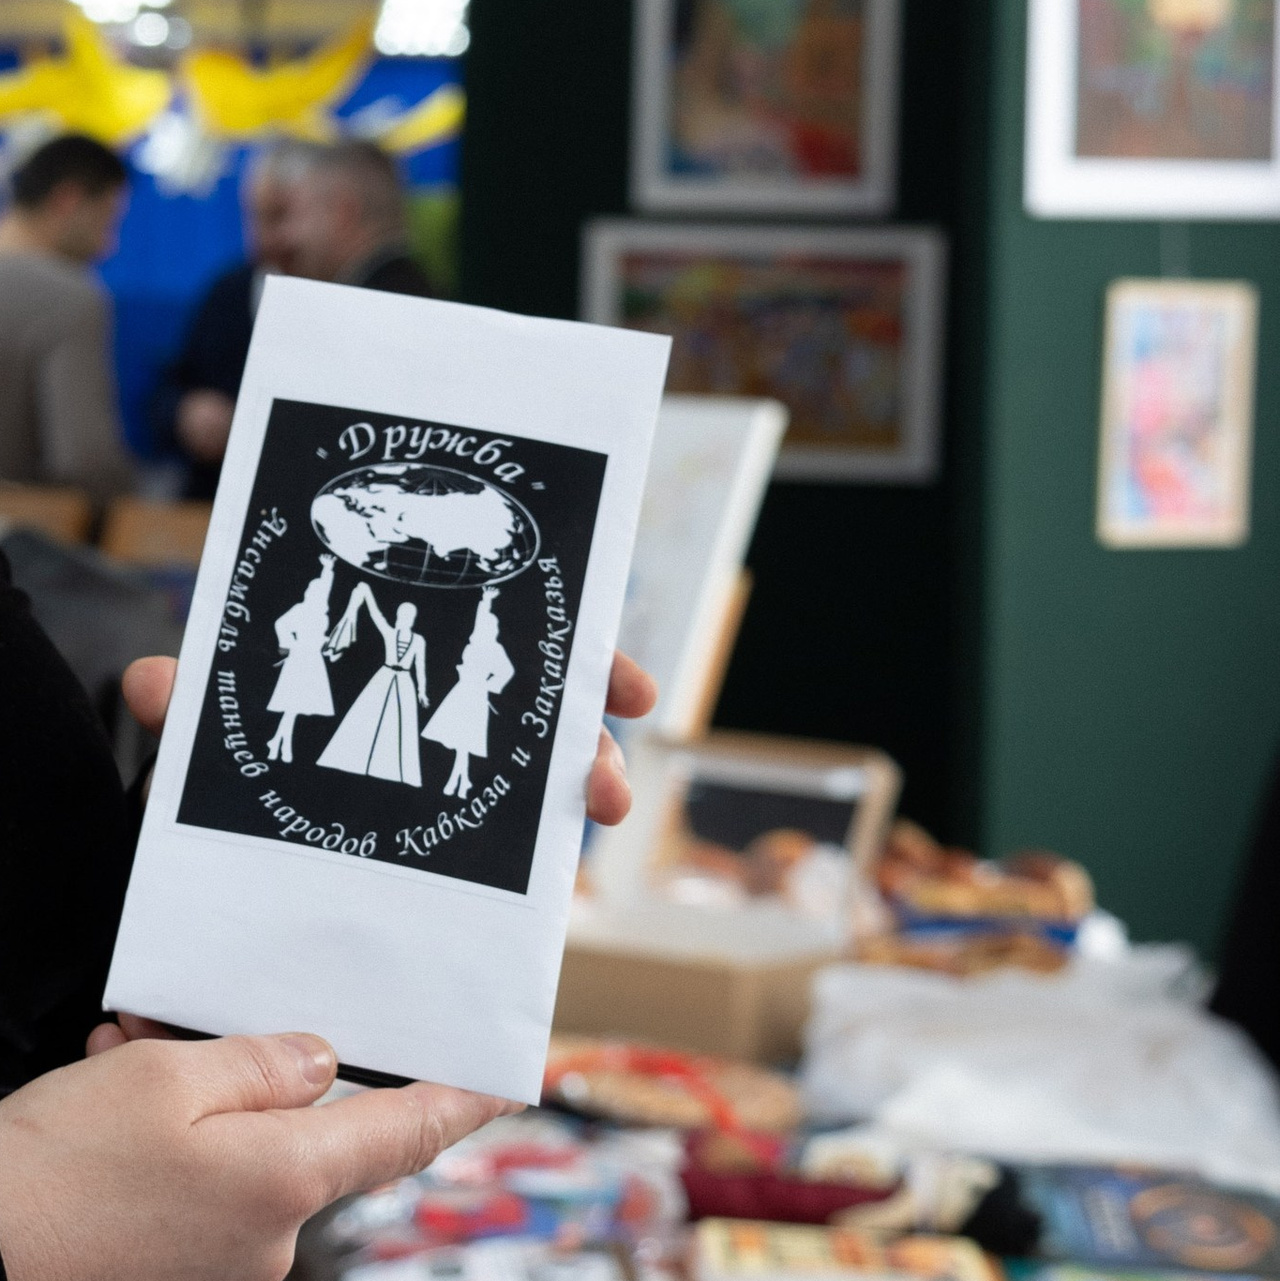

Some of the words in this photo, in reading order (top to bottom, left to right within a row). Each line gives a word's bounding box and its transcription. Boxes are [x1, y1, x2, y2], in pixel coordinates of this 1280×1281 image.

[217, 506, 288, 652] Ансамбль
[520, 556, 574, 739] Закавказья
[217, 670, 270, 778] танцев
[510, 746, 532, 768] и
[258, 790, 379, 859] народов
[395, 774, 512, 857] Кавказа
